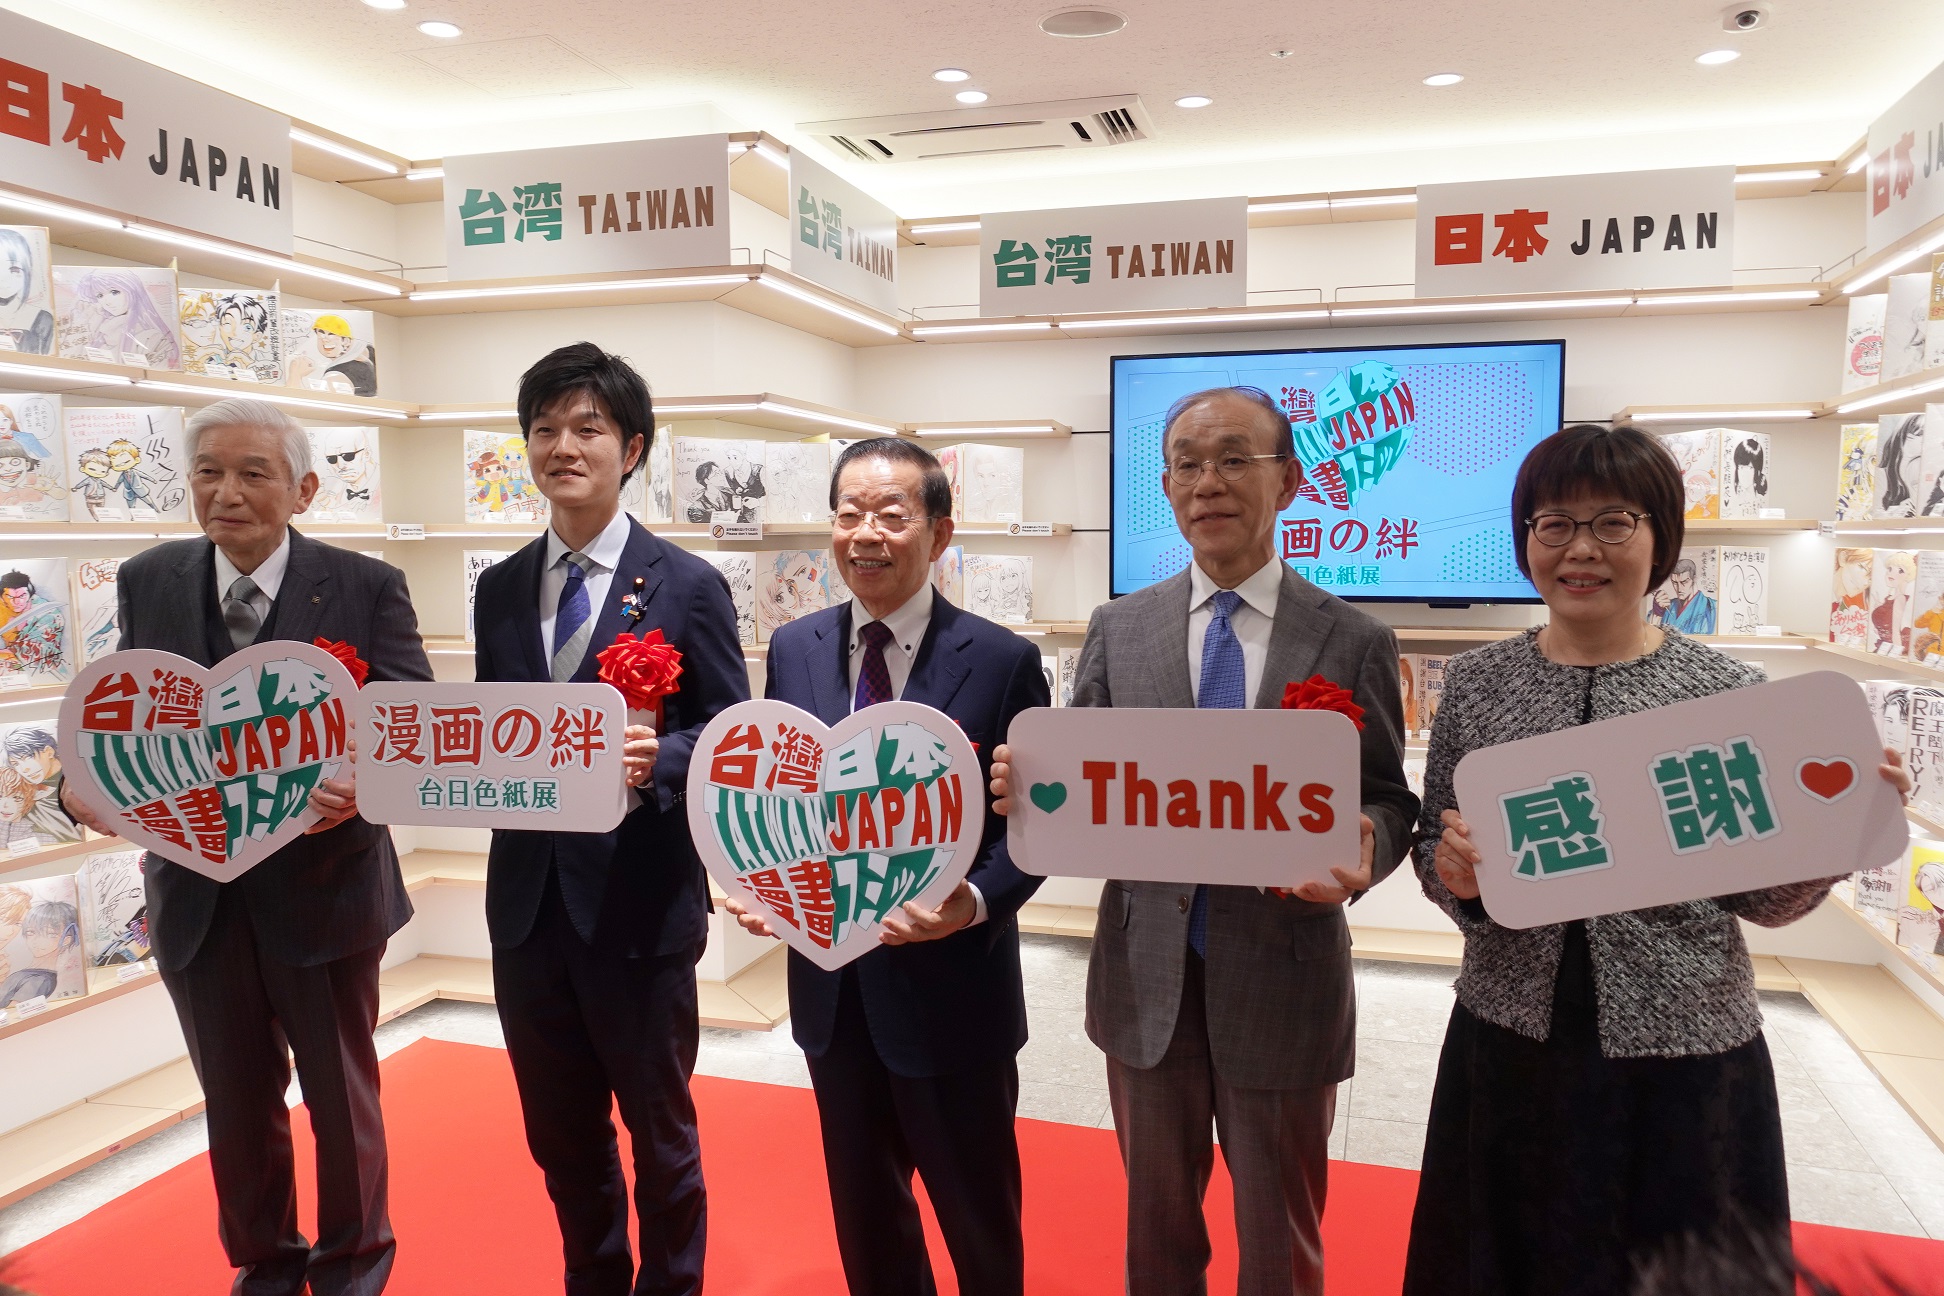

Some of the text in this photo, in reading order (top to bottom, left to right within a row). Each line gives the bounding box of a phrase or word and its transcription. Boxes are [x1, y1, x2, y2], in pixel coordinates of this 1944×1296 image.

[0, 57, 126, 163] 日本
[148, 128, 280, 210] JAPAN
[1873, 130, 1915, 218] 日本
[458, 182, 563, 246] 台湾
[578, 186, 714, 235] TAIWAN
[797, 185, 842, 261] 台湾
[1434, 208, 1549, 266] 日本
[1570, 212, 1718, 256] JAPAN
[847, 226, 894, 283] TAIWAN
[993, 234, 1092, 288] 台湾
[1106, 239, 1234, 279] TAIWAN
[1280, 386, 1317, 425] 灣
[1318, 359, 1400, 419] 日本
[1330, 381, 1415, 451] JAPAN
[677, 442, 697, 454] Thank
[1281, 517, 1419, 560] 画の絆
[1294, 565, 1380, 586] 日色紙展
[207, 657, 333, 726] 日本
[1427, 659, 1443, 669] BEEL
[1427, 680, 1443, 691] BUB
[82, 668, 204, 732] 台灣
[215, 697, 347, 778] JAPAN
[372, 703, 606, 769] 漫画の絆
[709, 722, 824, 794] 台灣
[824, 721, 954, 792] 日本
[76, 730, 216, 811] TAIWAN
[418, 777, 558, 809] 台日色紙展
[1083, 760, 1335, 834] Thanks
[119, 785, 228, 864] 漫畫
[703, 783, 828, 875] TAIWAN
[829, 774, 963, 852] JAPAN
[1503, 740, 1775, 877] 感謝
[736, 860, 836, 949] 漫畫
